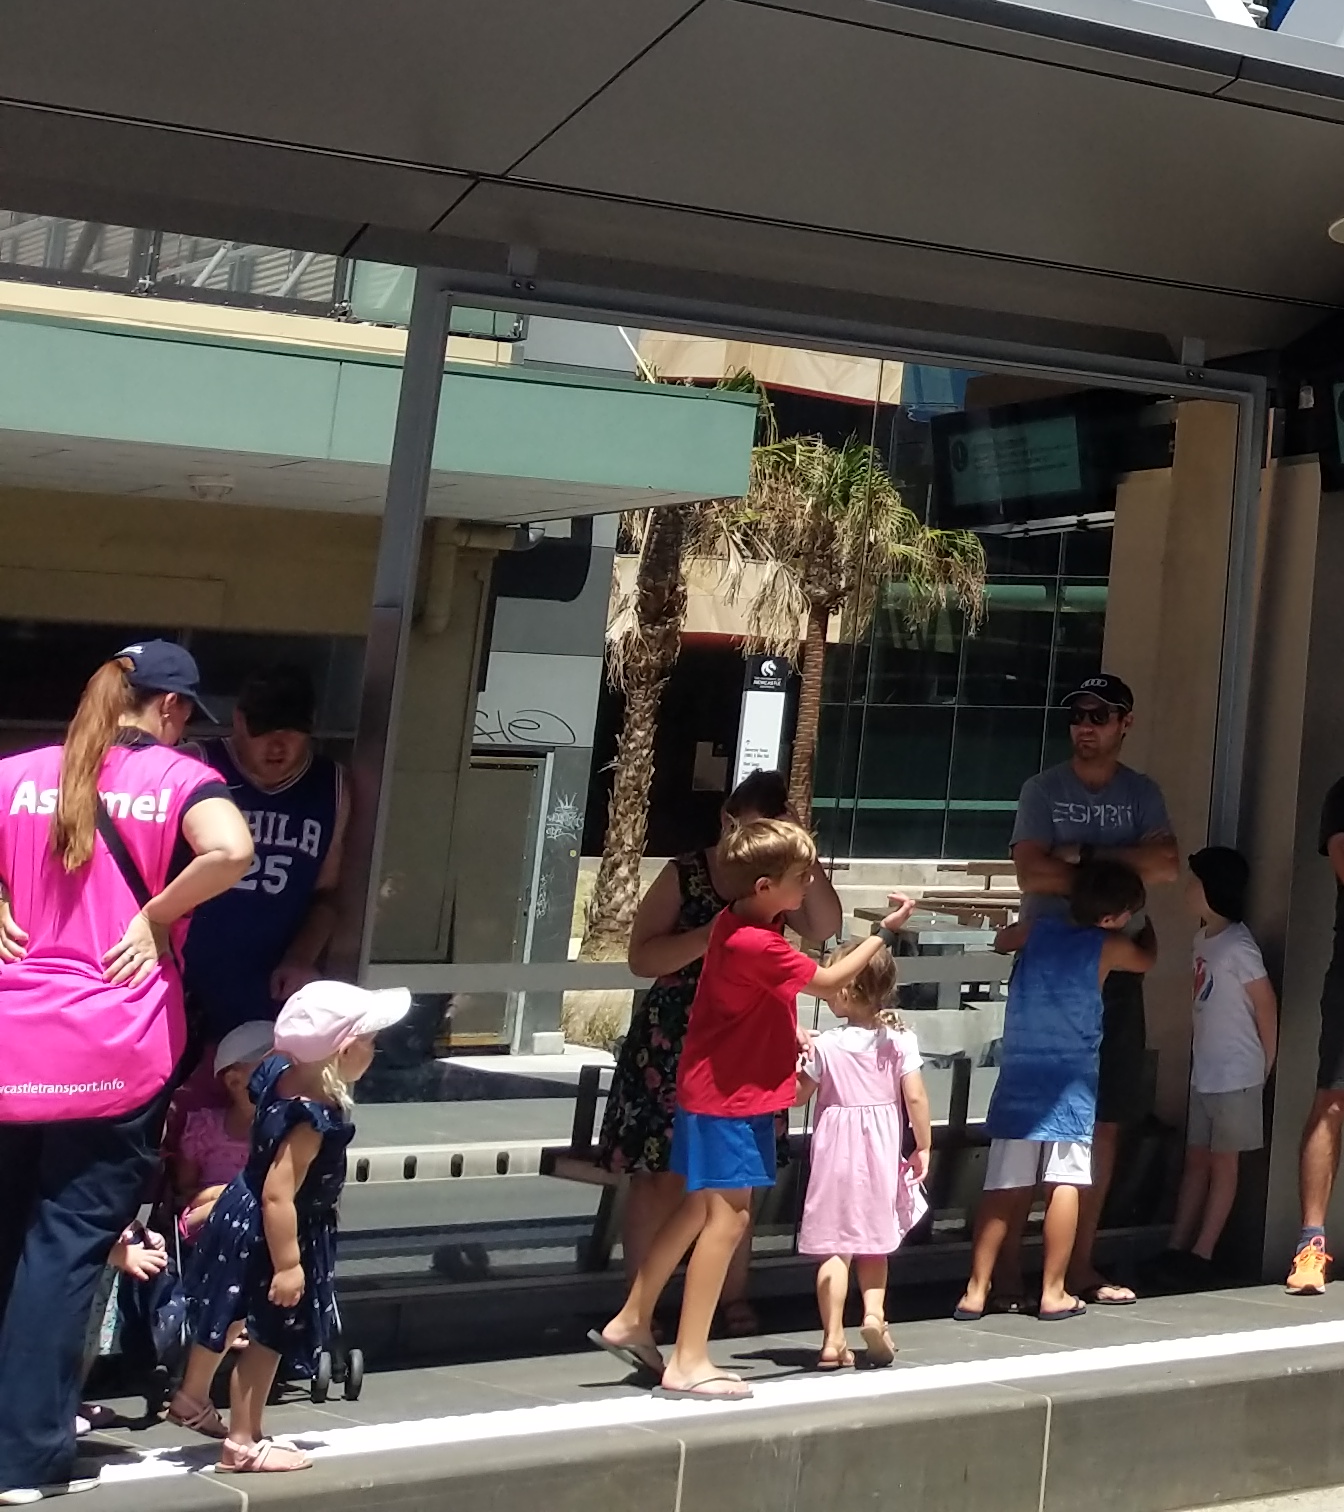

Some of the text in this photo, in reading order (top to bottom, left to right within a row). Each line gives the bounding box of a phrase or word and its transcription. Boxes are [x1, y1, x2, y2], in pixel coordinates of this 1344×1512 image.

[9, 780, 58, 815] As
[101, 788, 171, 823] me!
[245, 810, 322, 858] HILA
